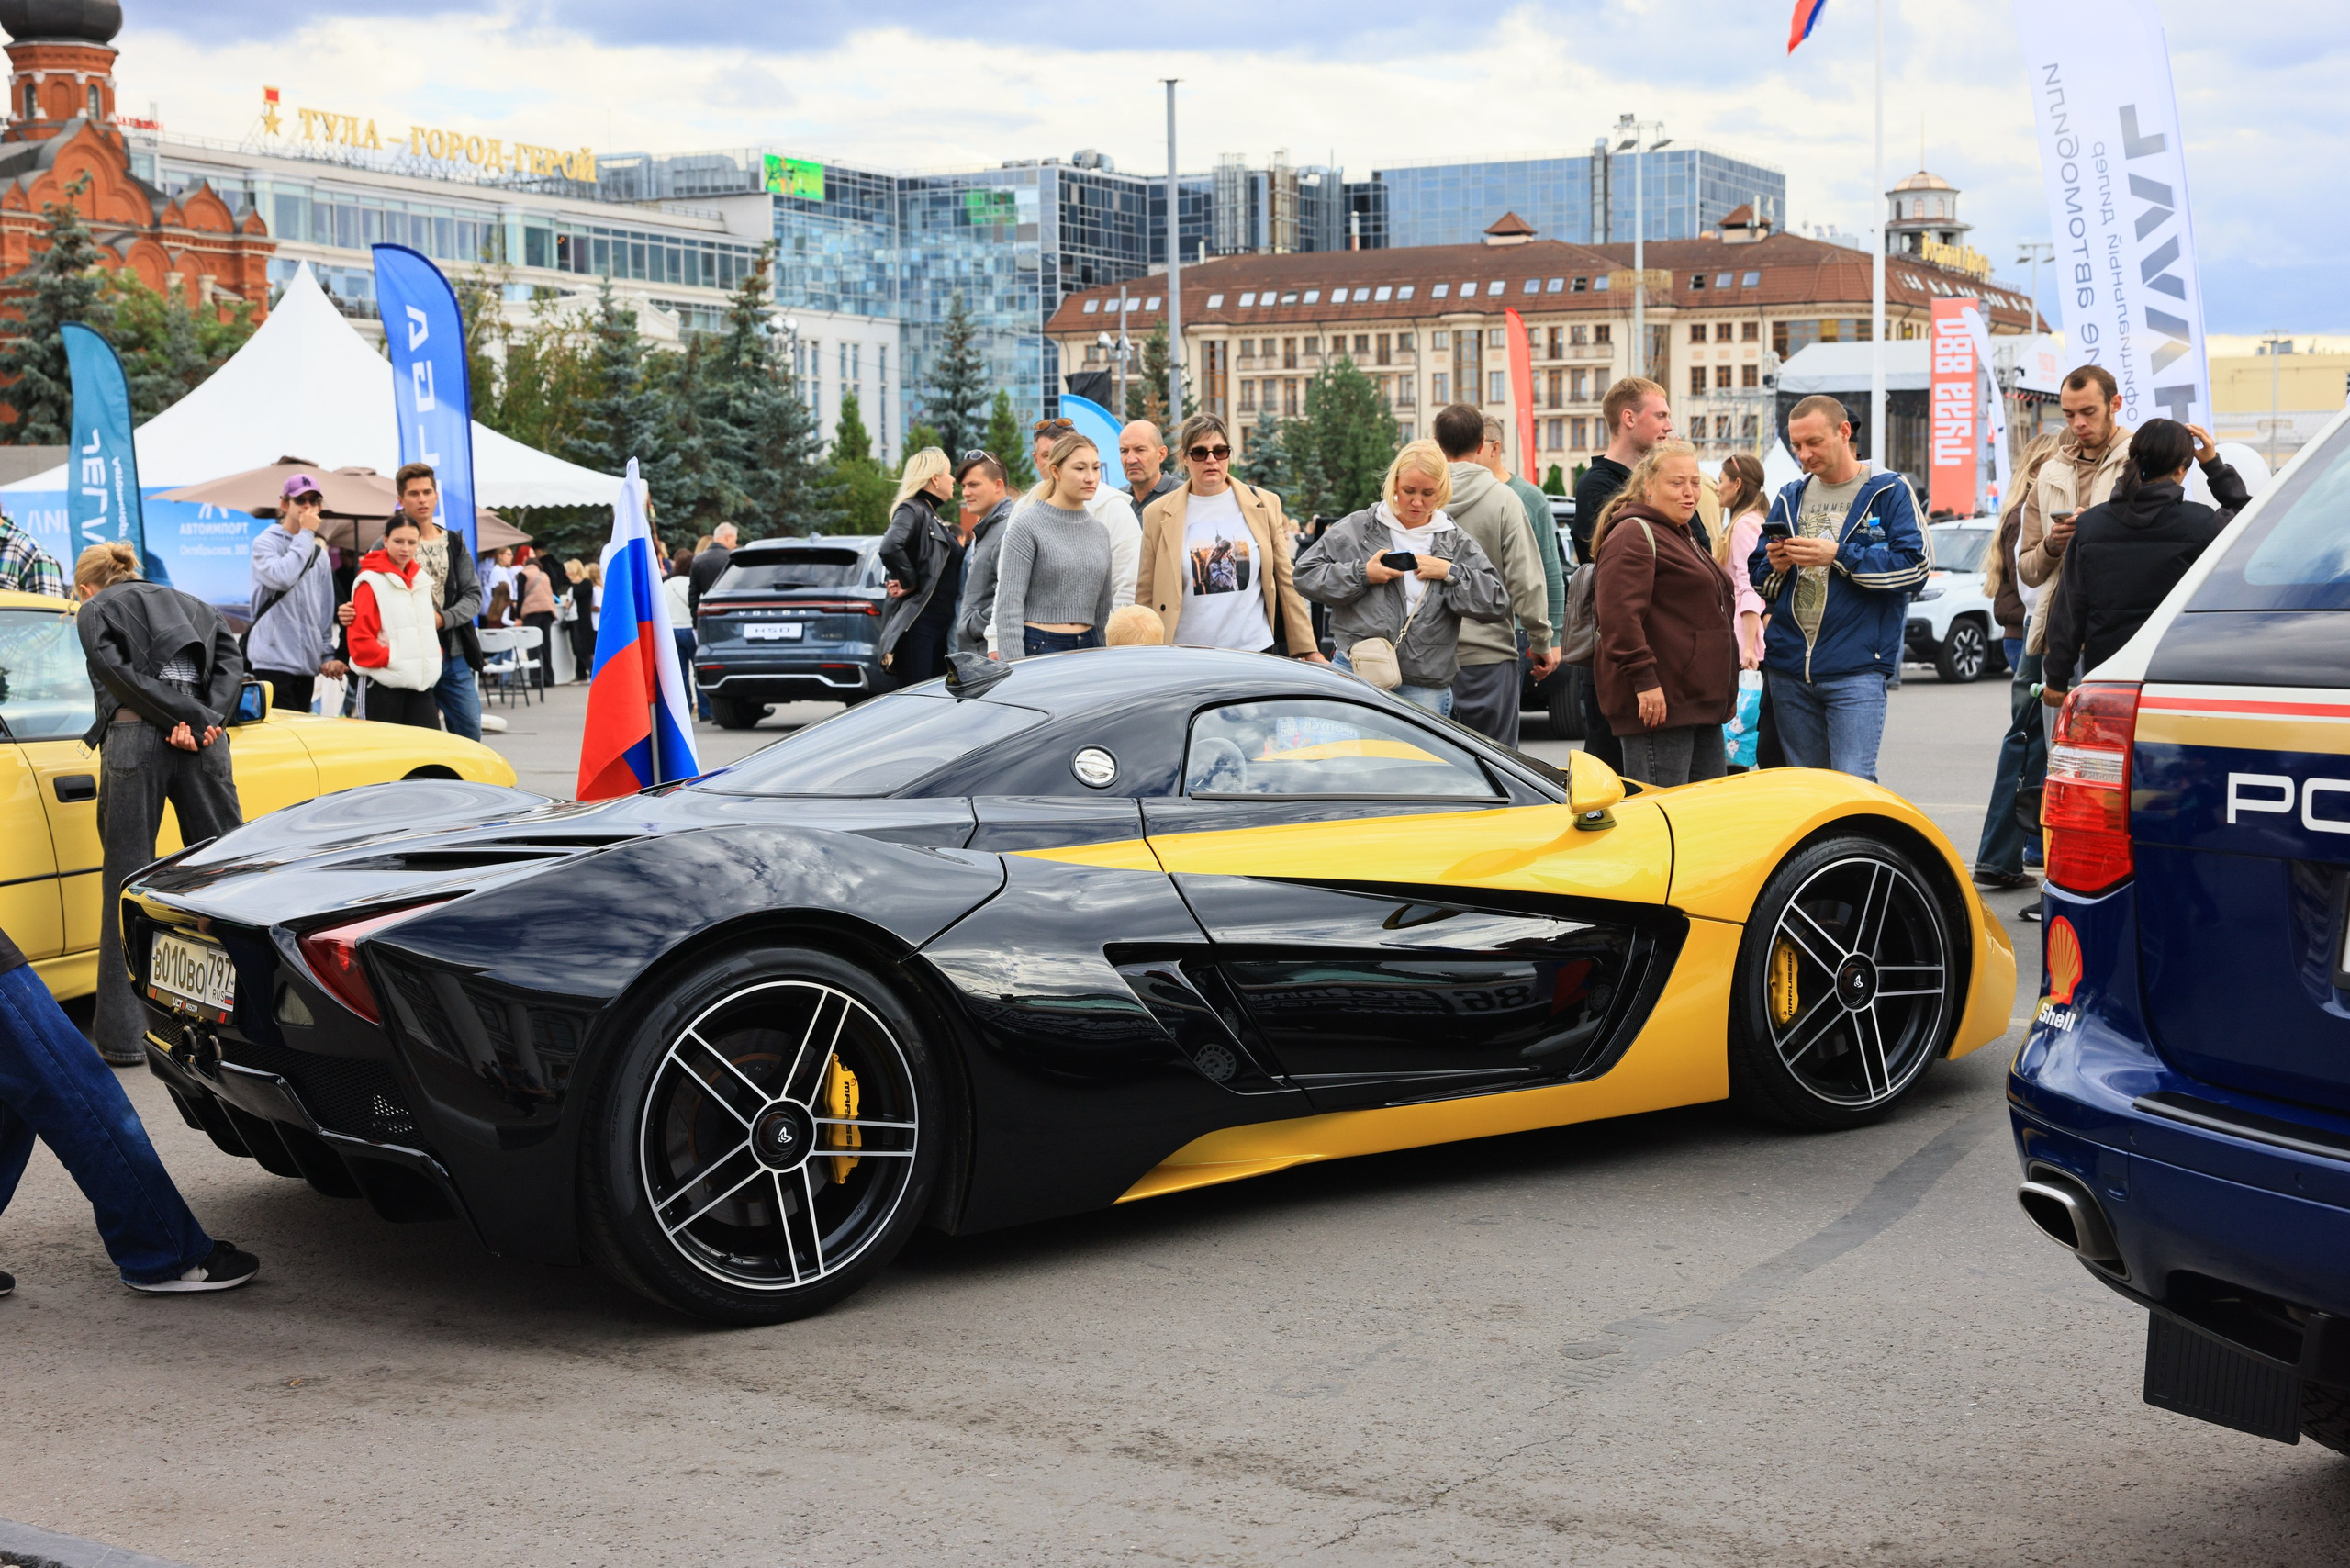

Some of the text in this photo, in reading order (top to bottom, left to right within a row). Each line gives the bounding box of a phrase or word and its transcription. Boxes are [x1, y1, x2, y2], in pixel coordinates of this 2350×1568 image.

[298, 108, 384, 151] ТУЛА
[410, 125, 598, 183] ГОРОД-ГЕРОЙ
[1810, 501, 1852, 514] SUMMER
[179, 522, 249, 536] АВТОИМПОРТ
[208, 953, 233, 991] 797
[212, 988, 225, 1002] RUS
[2038, 1002, 2076, 1033] Shell
